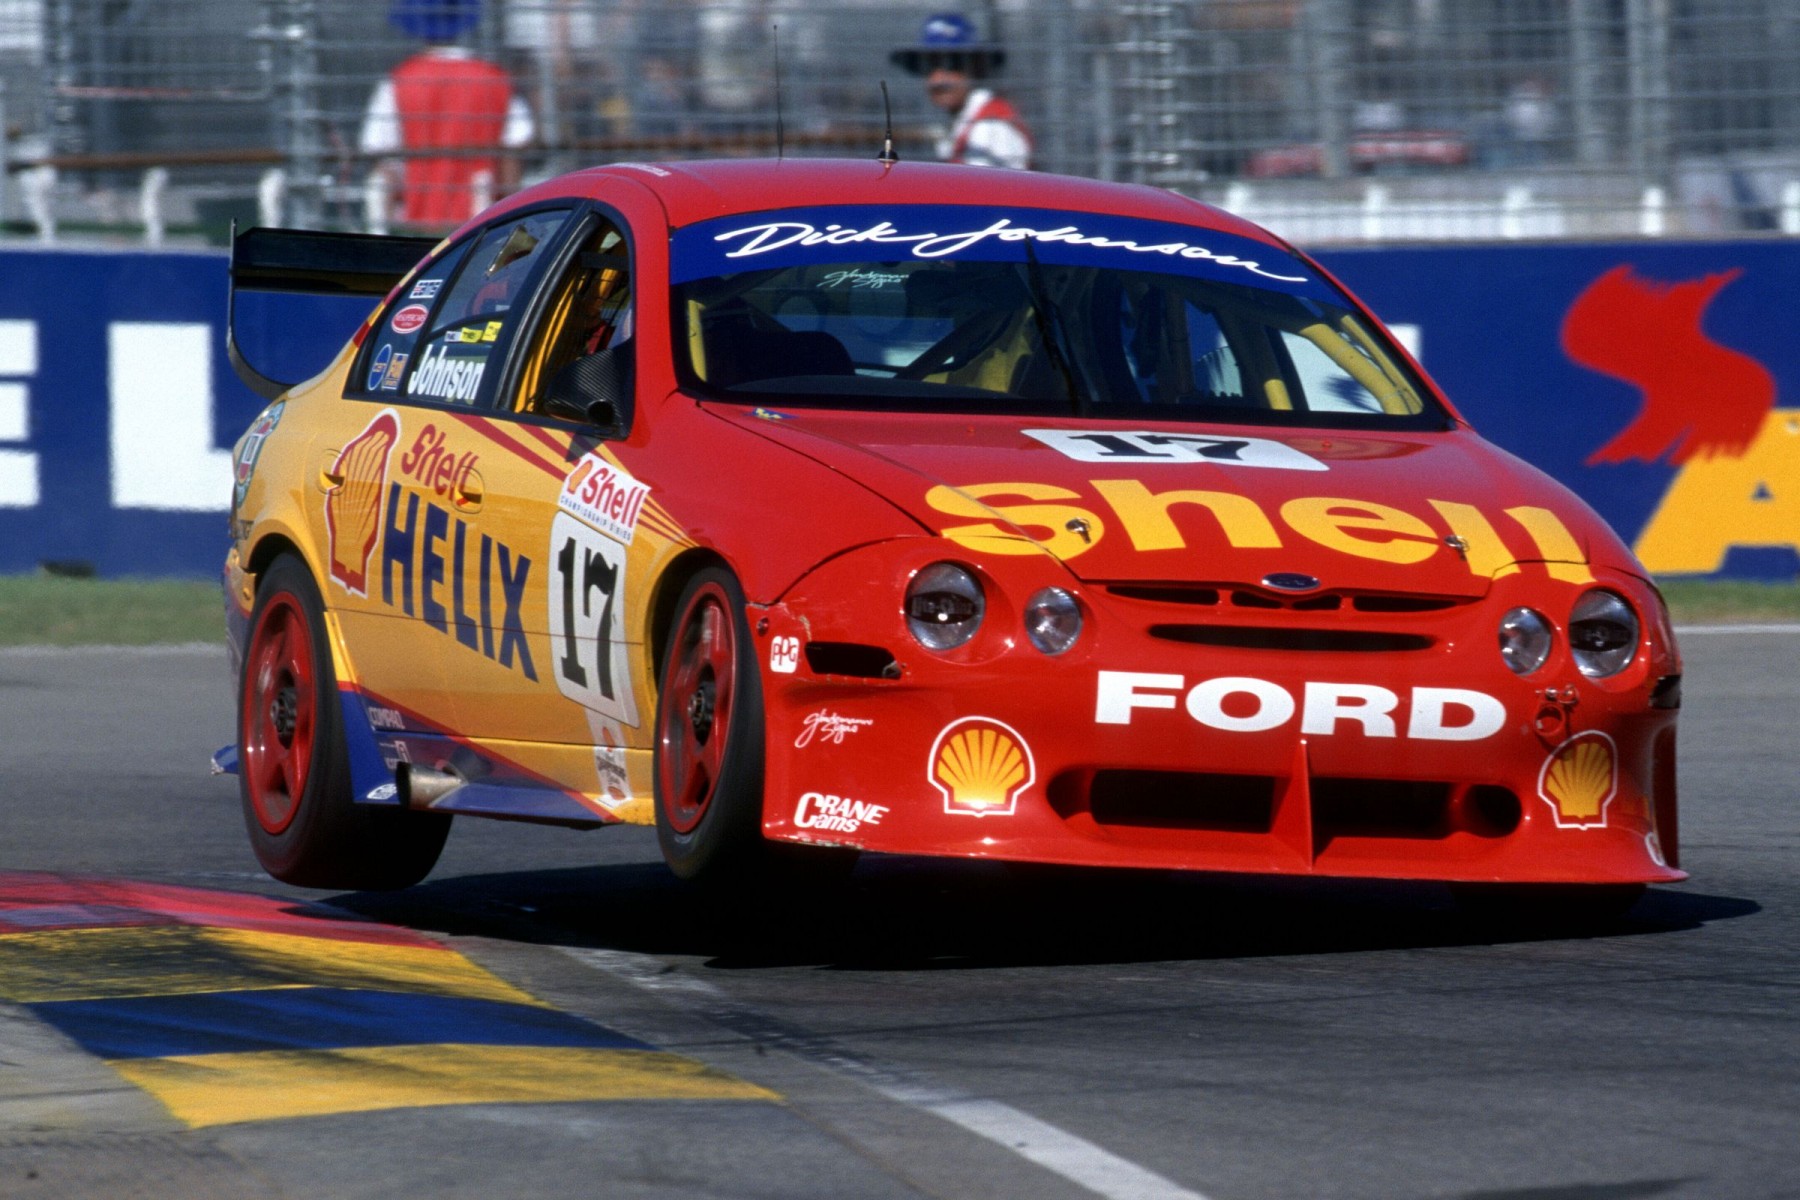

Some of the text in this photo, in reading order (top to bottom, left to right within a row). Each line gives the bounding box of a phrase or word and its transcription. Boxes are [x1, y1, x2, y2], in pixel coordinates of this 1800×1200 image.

[714, 218, 1308, 283] Dick Johnson
[407, 343, 486, 400] Johnson
[402, 423, 480, 505] Shell
[1070, 433, 1252, 461] 17
[582, 467, 645, 528] Shell
[925, 478, 1596, 585] Shell
[381, 480, 540, 684] HELIX
[557, 536, 621, 703] 17
[1094, 670, 1507, 742] FORD
[794, 792, 890, 829] CRANE
